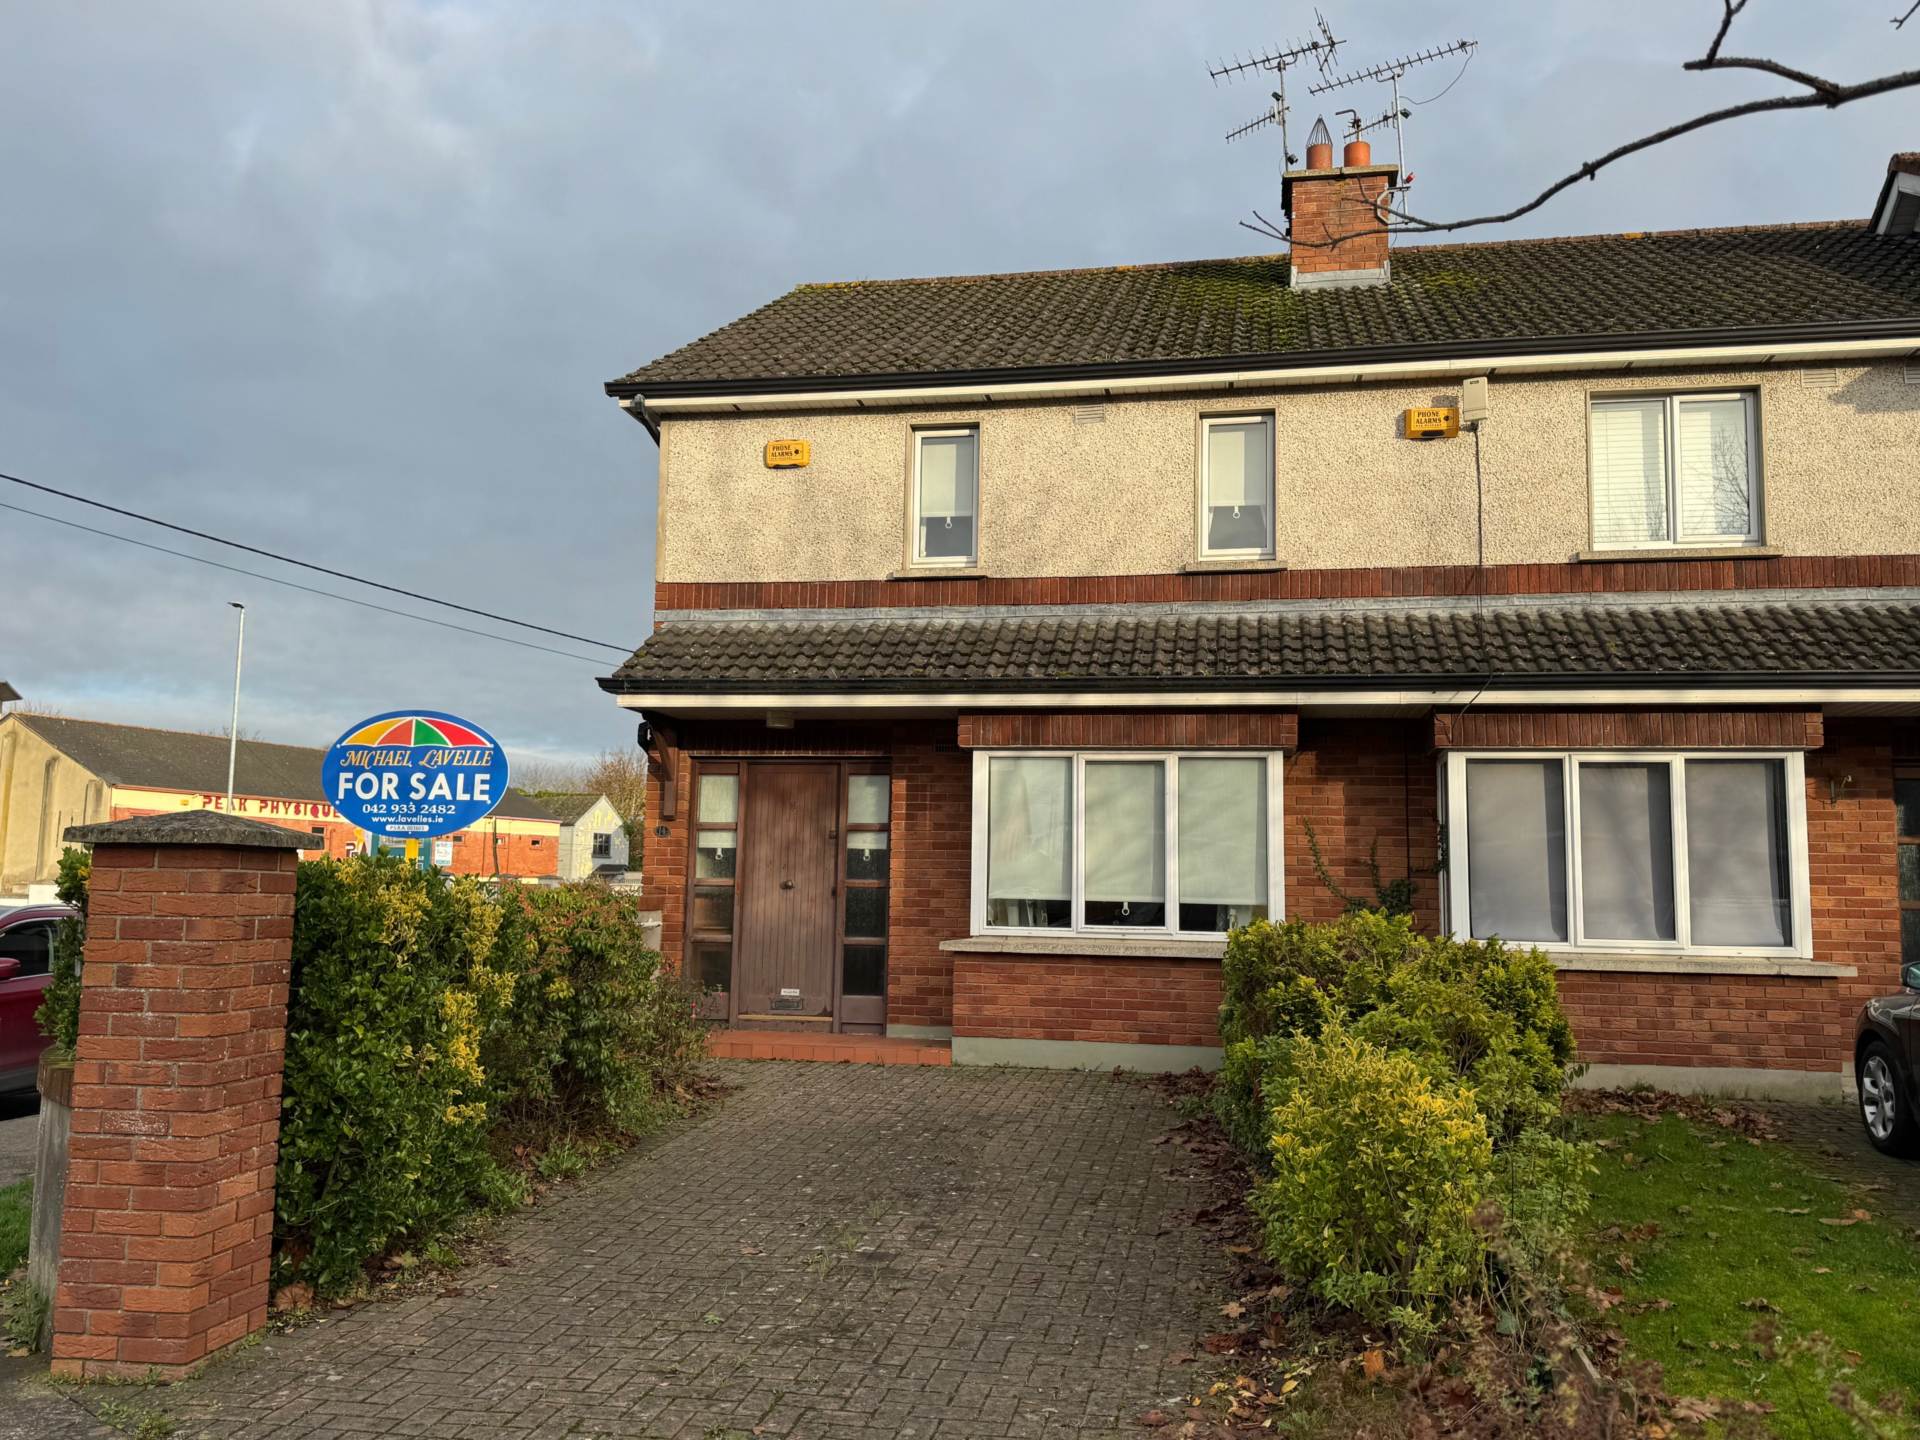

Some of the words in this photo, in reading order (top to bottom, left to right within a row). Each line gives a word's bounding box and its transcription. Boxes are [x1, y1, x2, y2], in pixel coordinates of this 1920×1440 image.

[340, 750, 413, 769] MICHAEL
[418, 750, 494, 769] LAVELLE
[338, 772, 400, 800] FOR
[409, 772, 491, 801] SALE
[362, 804, 387, 814] 042
[391, 804, 416, 814] 933
[420, 804, 456, 814] 2482
[371, 815, 444, 824] www.lavelles.ie
